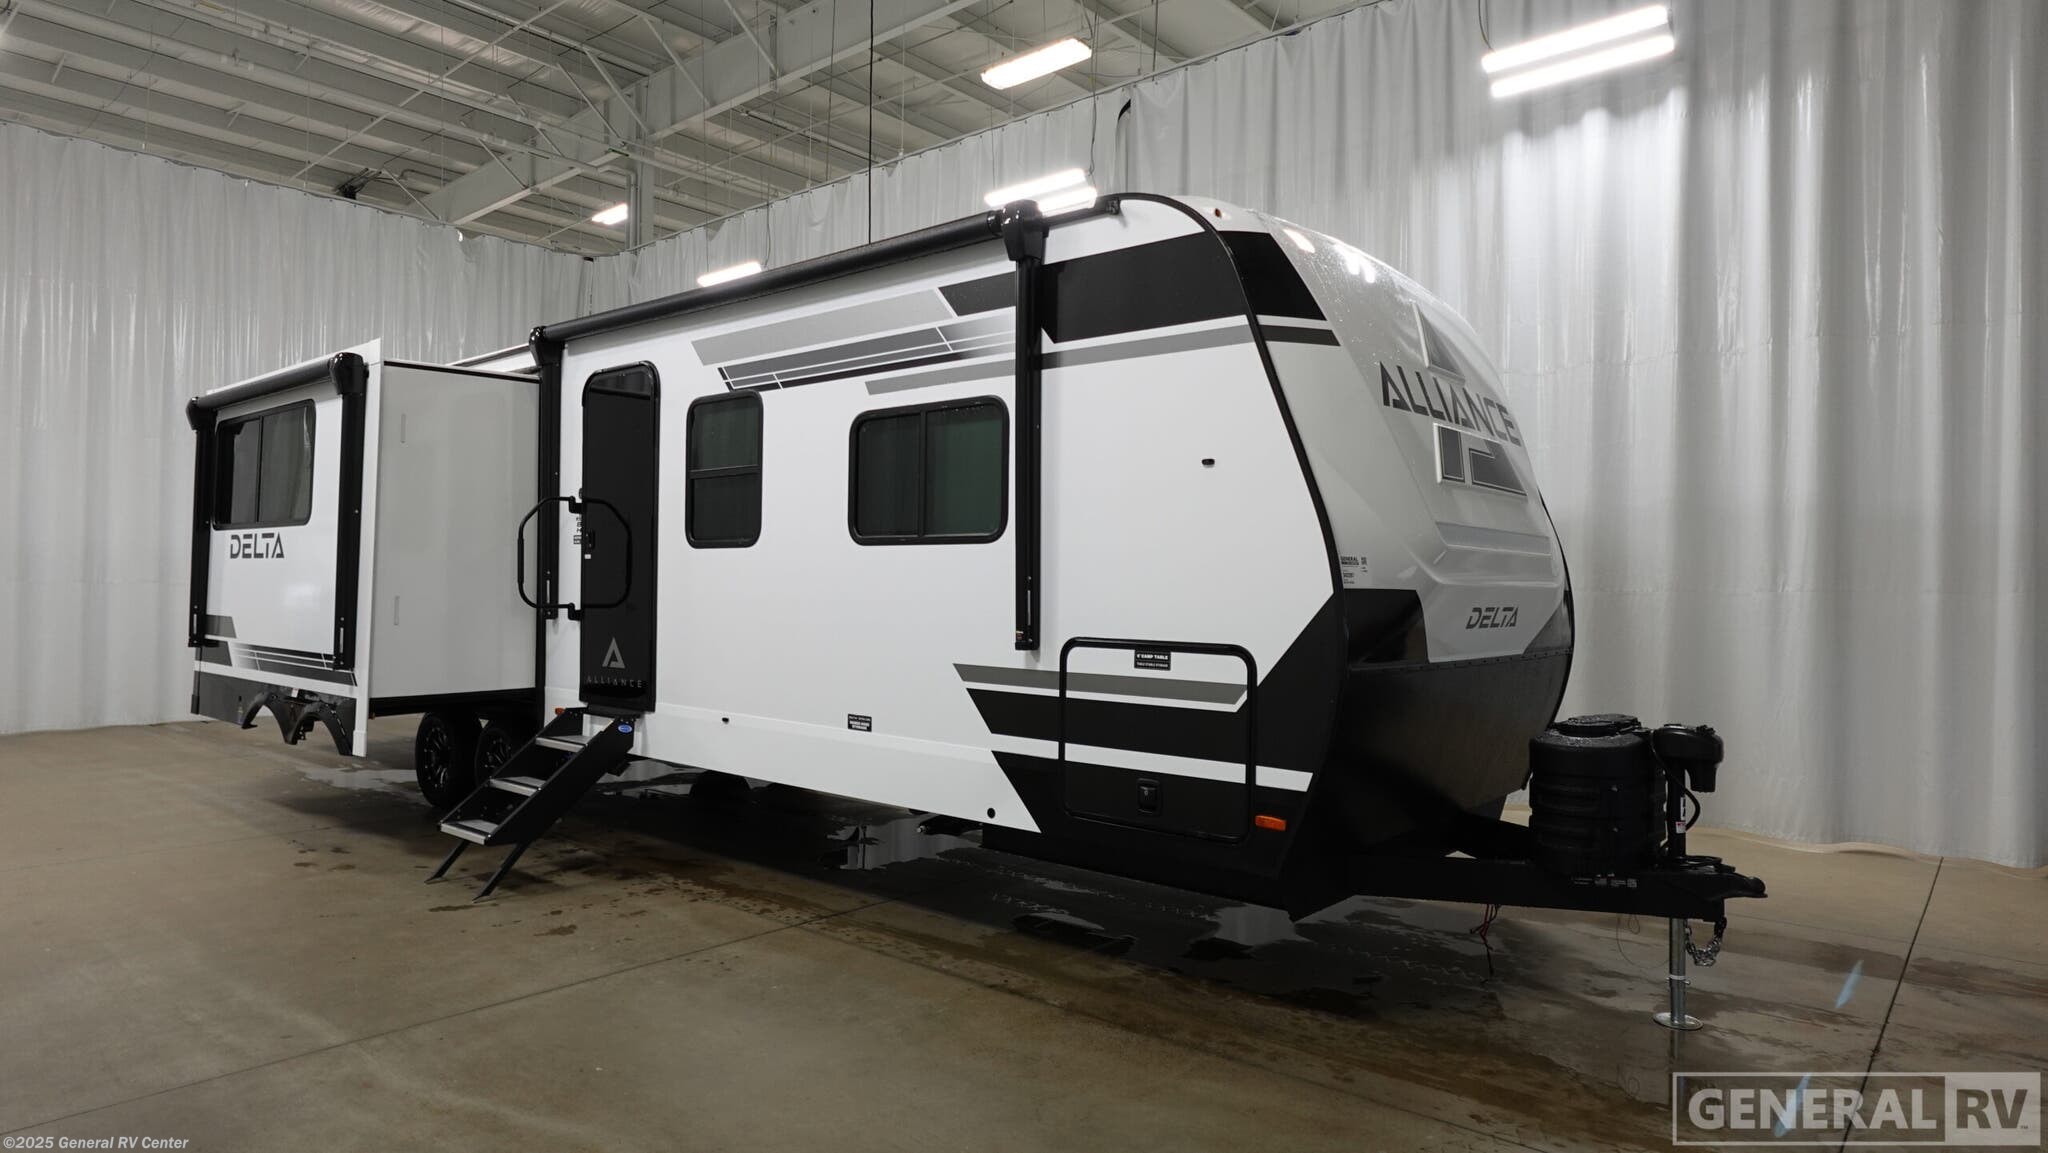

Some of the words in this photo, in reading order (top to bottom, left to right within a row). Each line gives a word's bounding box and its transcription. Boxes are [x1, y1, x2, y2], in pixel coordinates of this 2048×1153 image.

[1380, 361, 1521, 447] ALLIANCE
[230, 532, 285, 559] DELTA
[1465, 606, 1519, 630] DELTA
[586, 675, 642, 688] ALLIANCE
